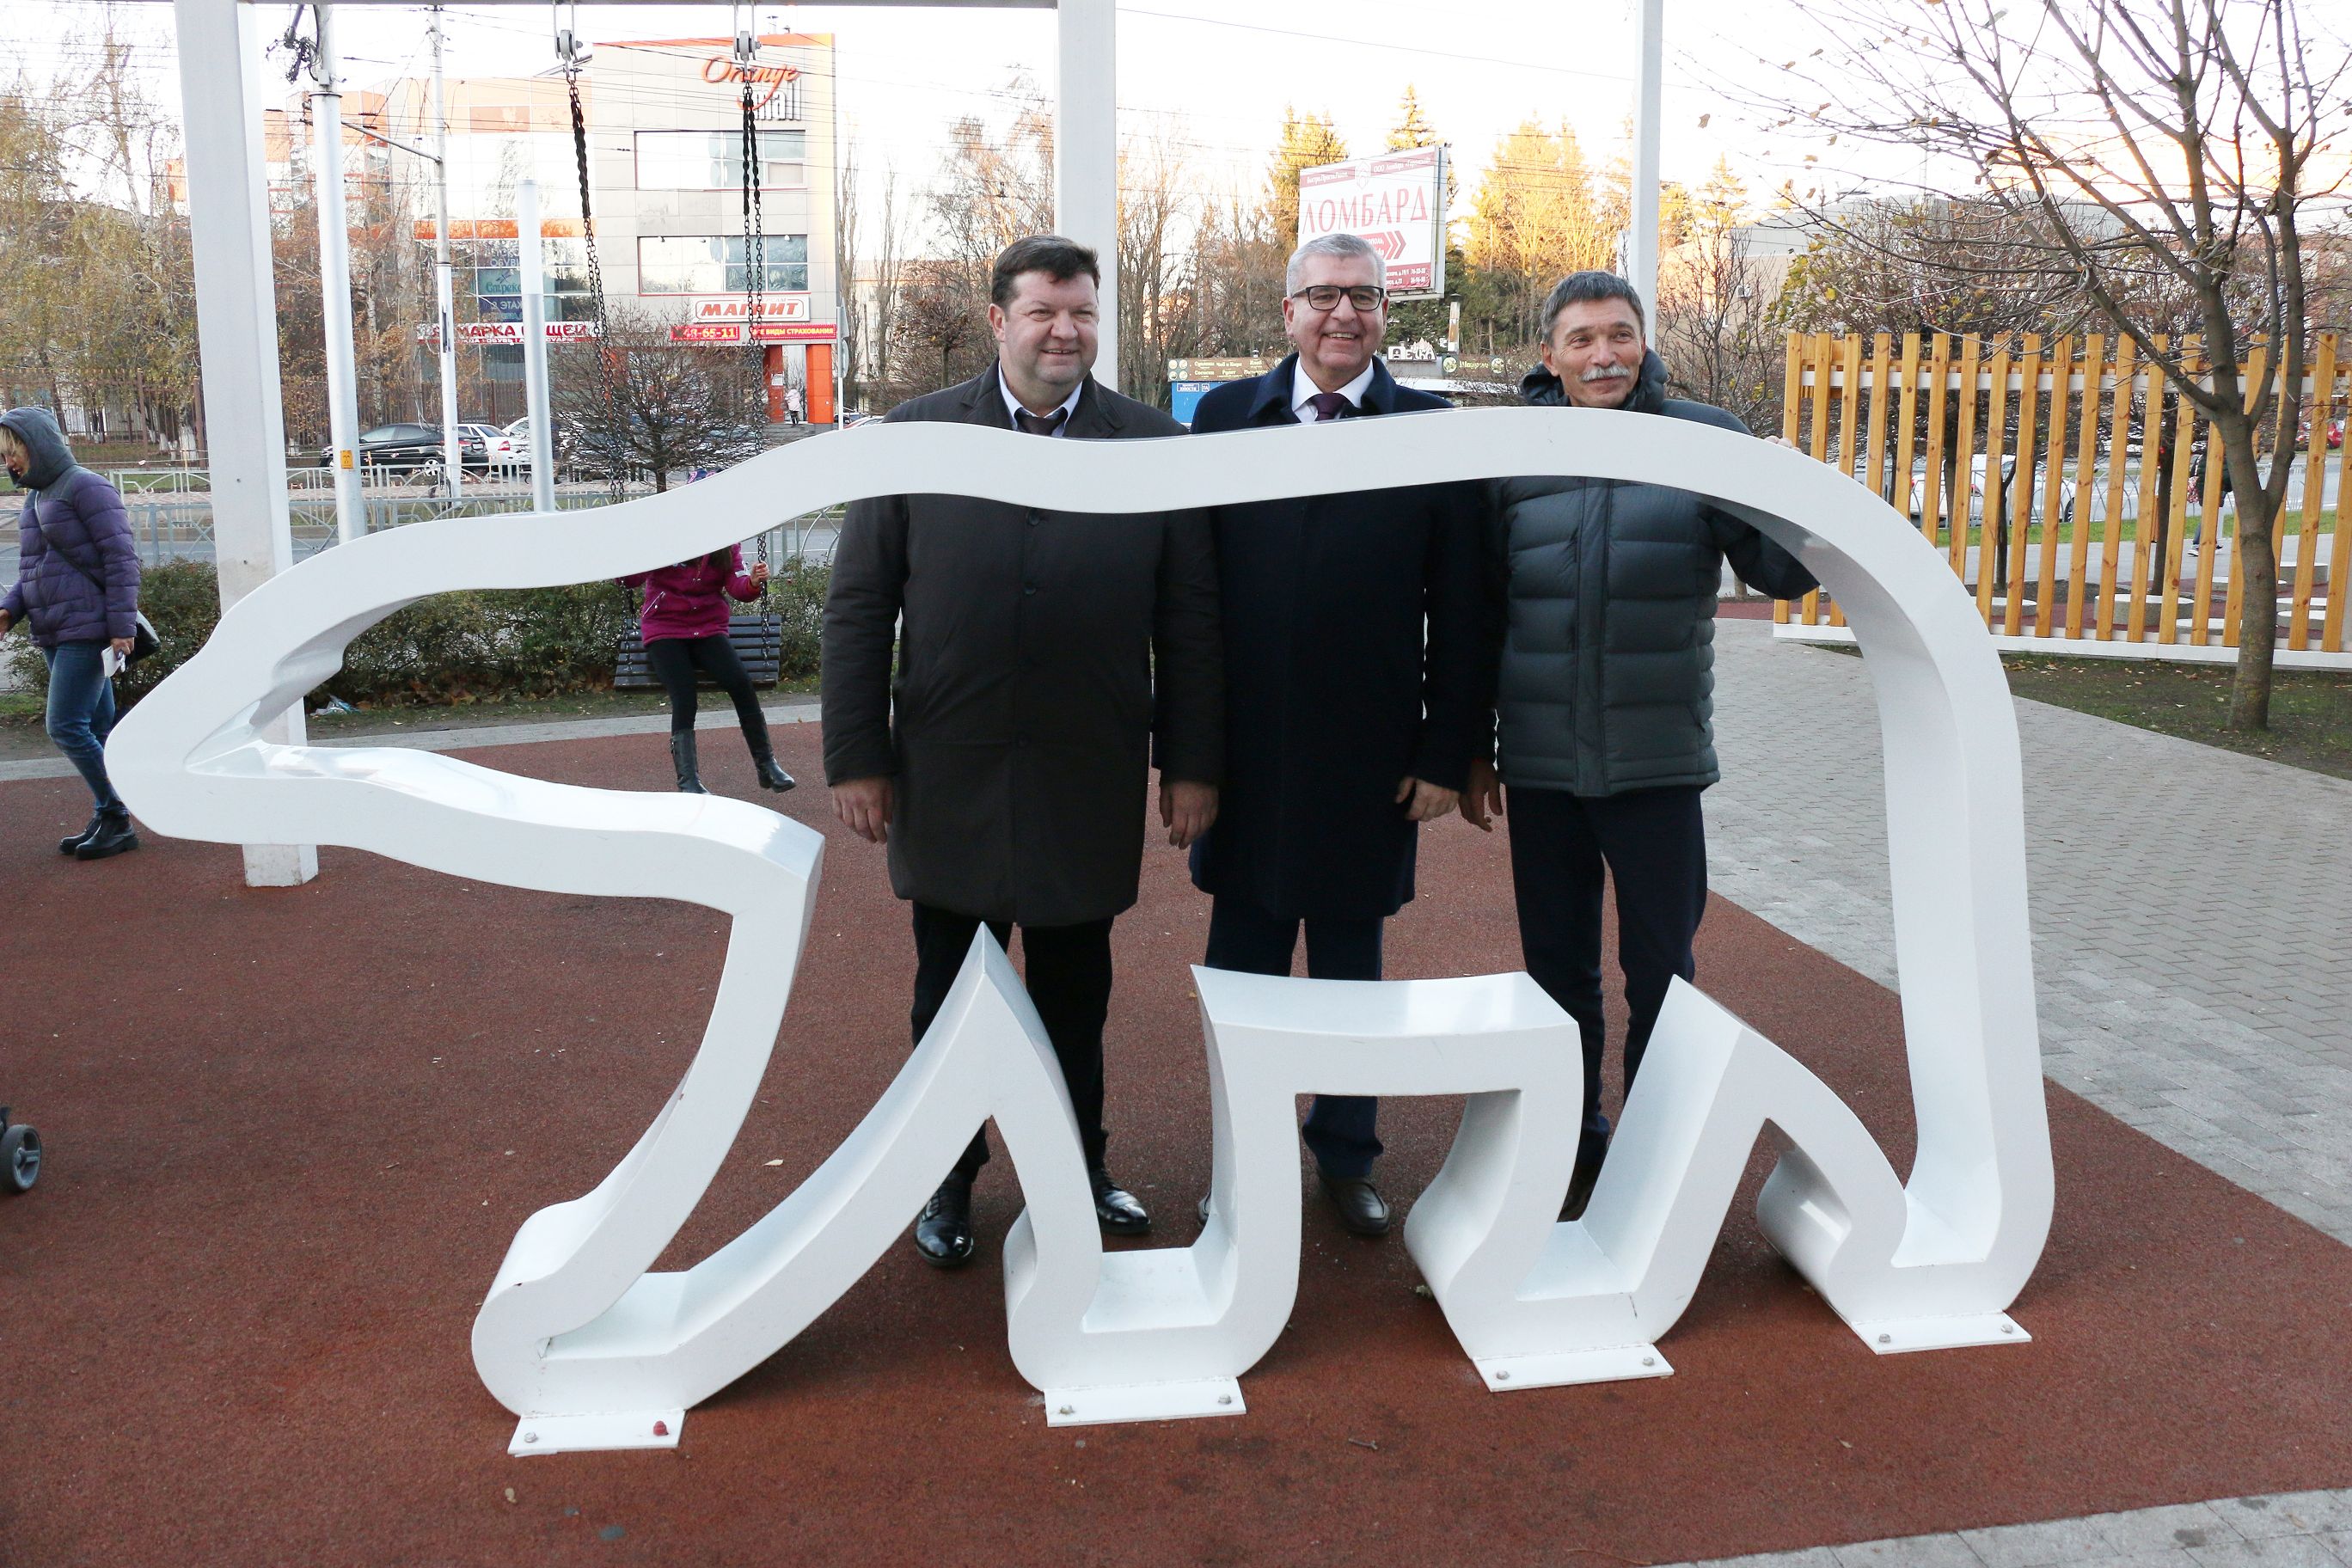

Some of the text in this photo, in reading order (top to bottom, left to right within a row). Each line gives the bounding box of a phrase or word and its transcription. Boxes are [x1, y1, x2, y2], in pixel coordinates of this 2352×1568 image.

[752, 78, 801, 120] mall
[1302, 185, 1428, 235] ЛОМБАРД
[701, 303, 798, 316] МАГНИТ
